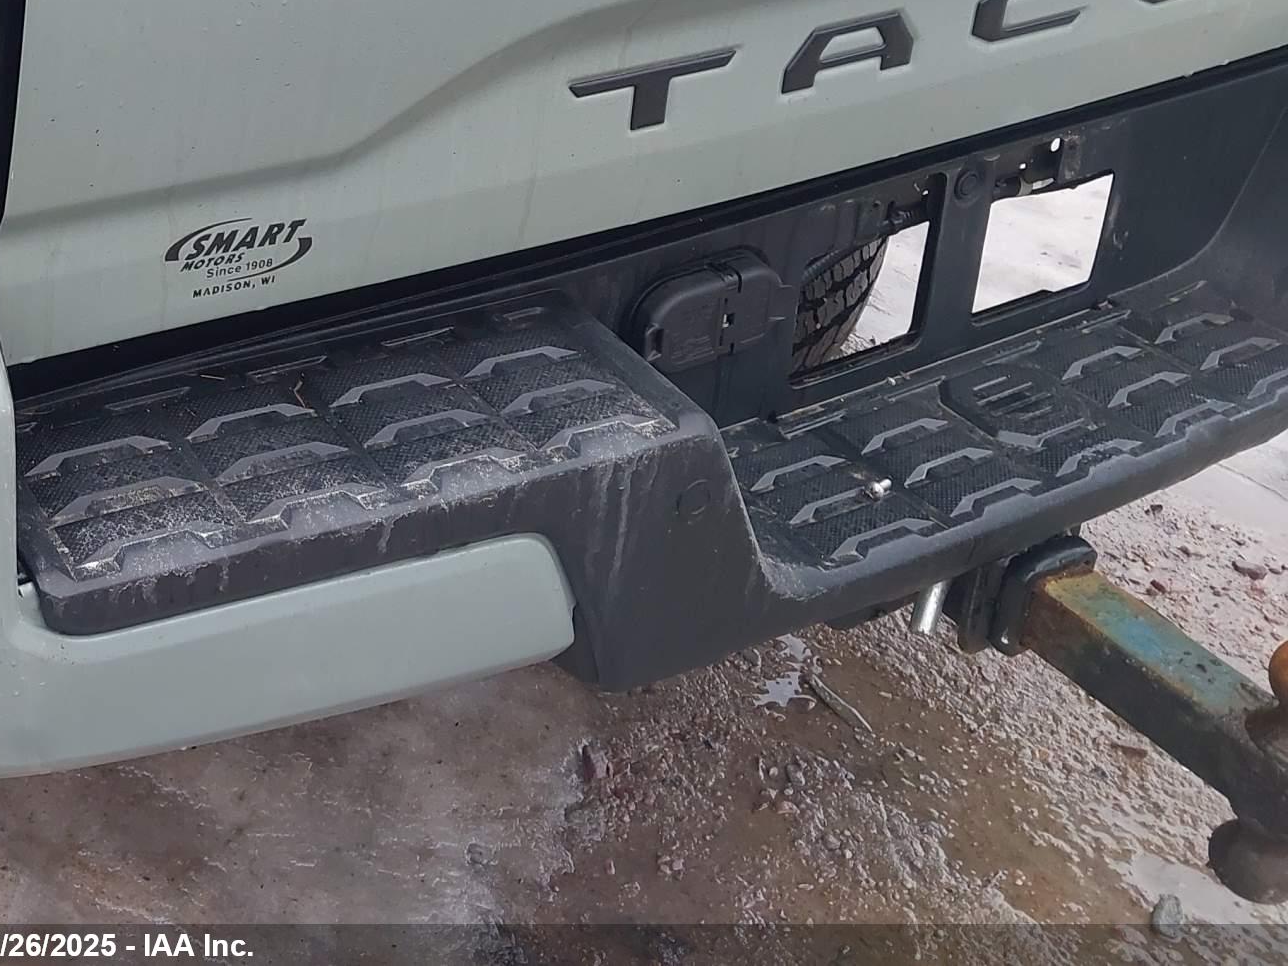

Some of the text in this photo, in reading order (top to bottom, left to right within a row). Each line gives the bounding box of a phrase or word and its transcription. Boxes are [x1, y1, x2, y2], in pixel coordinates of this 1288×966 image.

[185, 218, 306, 261] SMART
[180, 252, 245, 272] MOTORS
[206, 258, 273, 279] Since 1908
[192, 275, 275, 298] MADISON, WI
